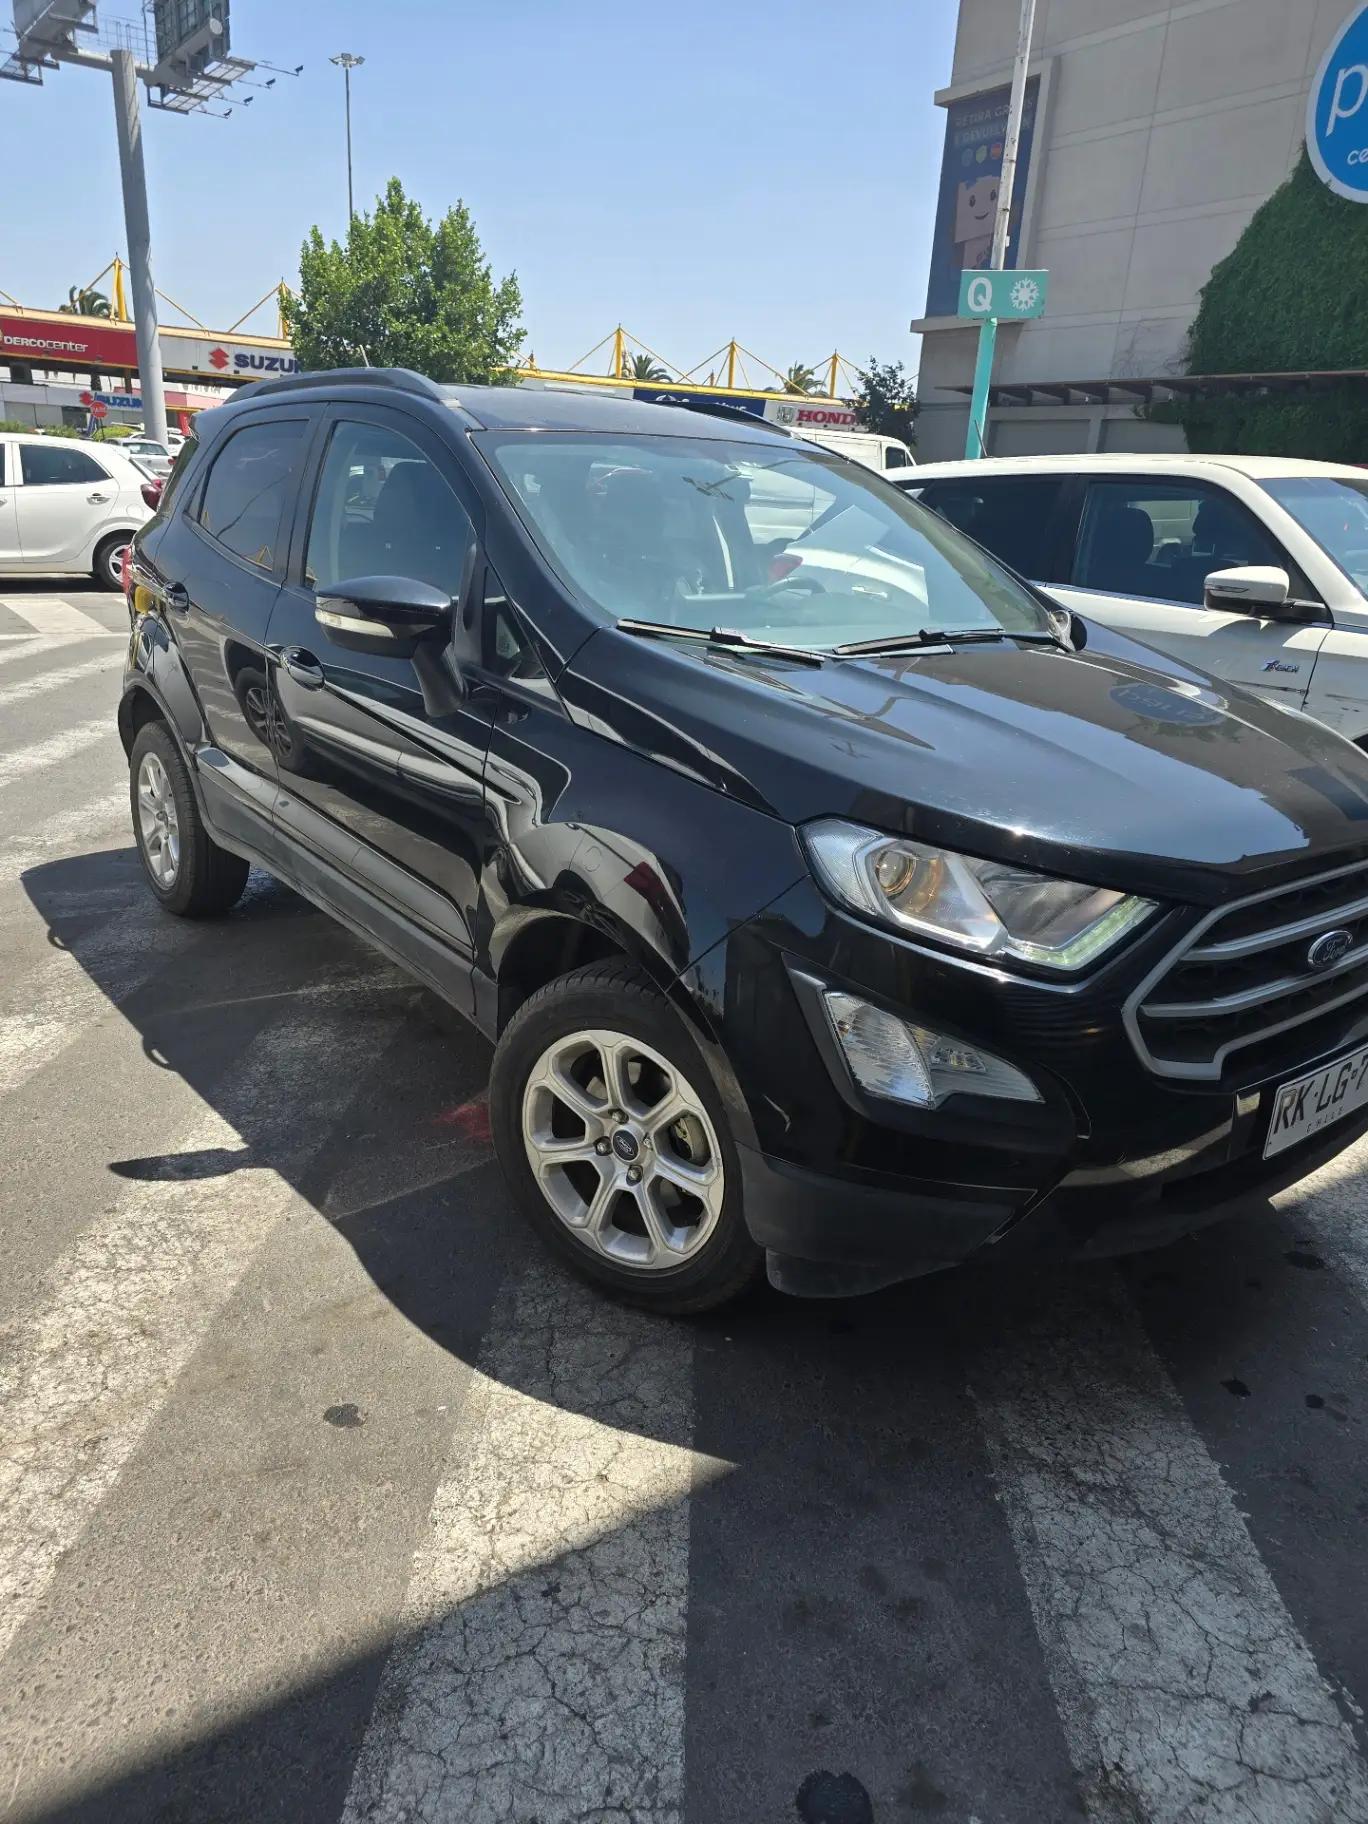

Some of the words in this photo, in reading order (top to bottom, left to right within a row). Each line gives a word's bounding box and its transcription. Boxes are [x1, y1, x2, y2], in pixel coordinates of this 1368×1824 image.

[967, 277, 992, 312] Q
[3, 336, 89, 352] DERCOcenter
[796, 410, 856, 425] HOND
